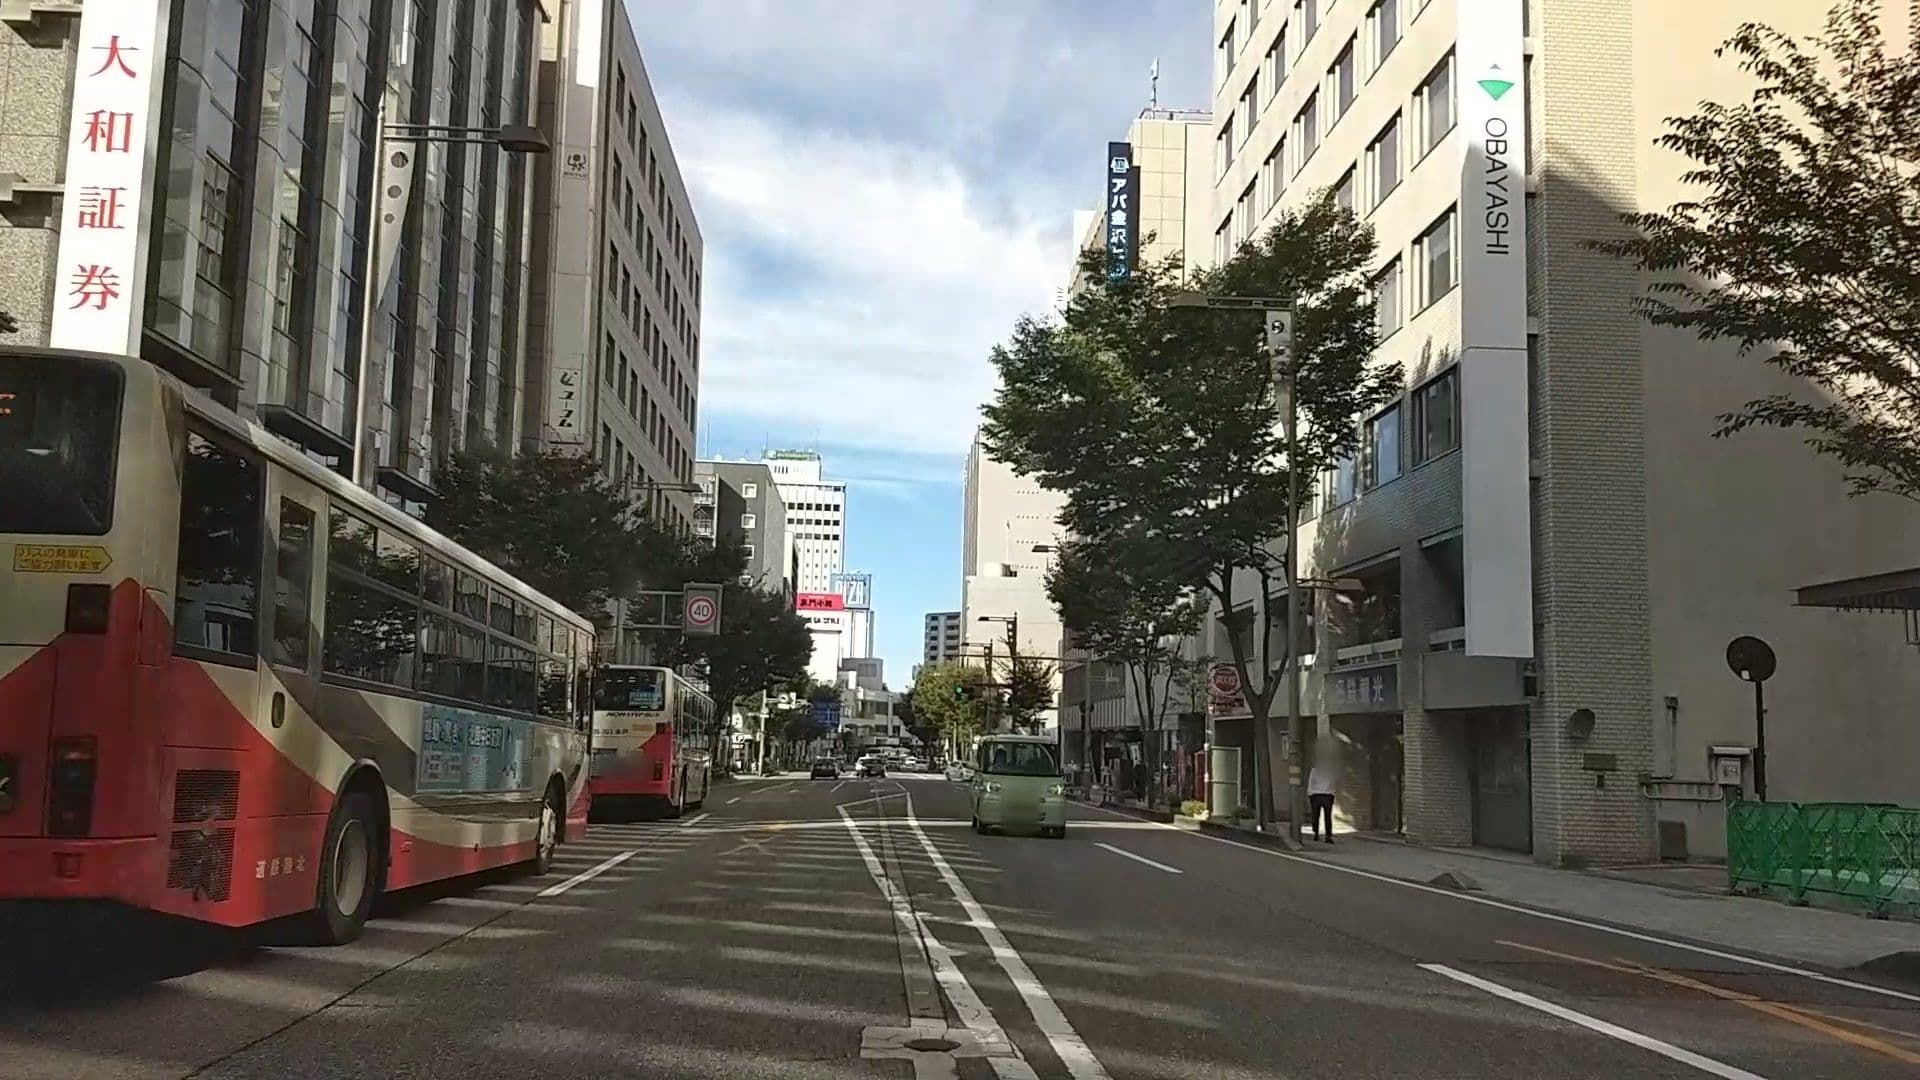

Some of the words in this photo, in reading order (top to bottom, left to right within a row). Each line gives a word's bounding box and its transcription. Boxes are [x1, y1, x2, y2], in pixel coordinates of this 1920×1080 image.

[68, 34, 140, 311] 大和証券
[1485, 117, 1509, 255] OBAYASHI
[693, 604, 710, 617] 40
